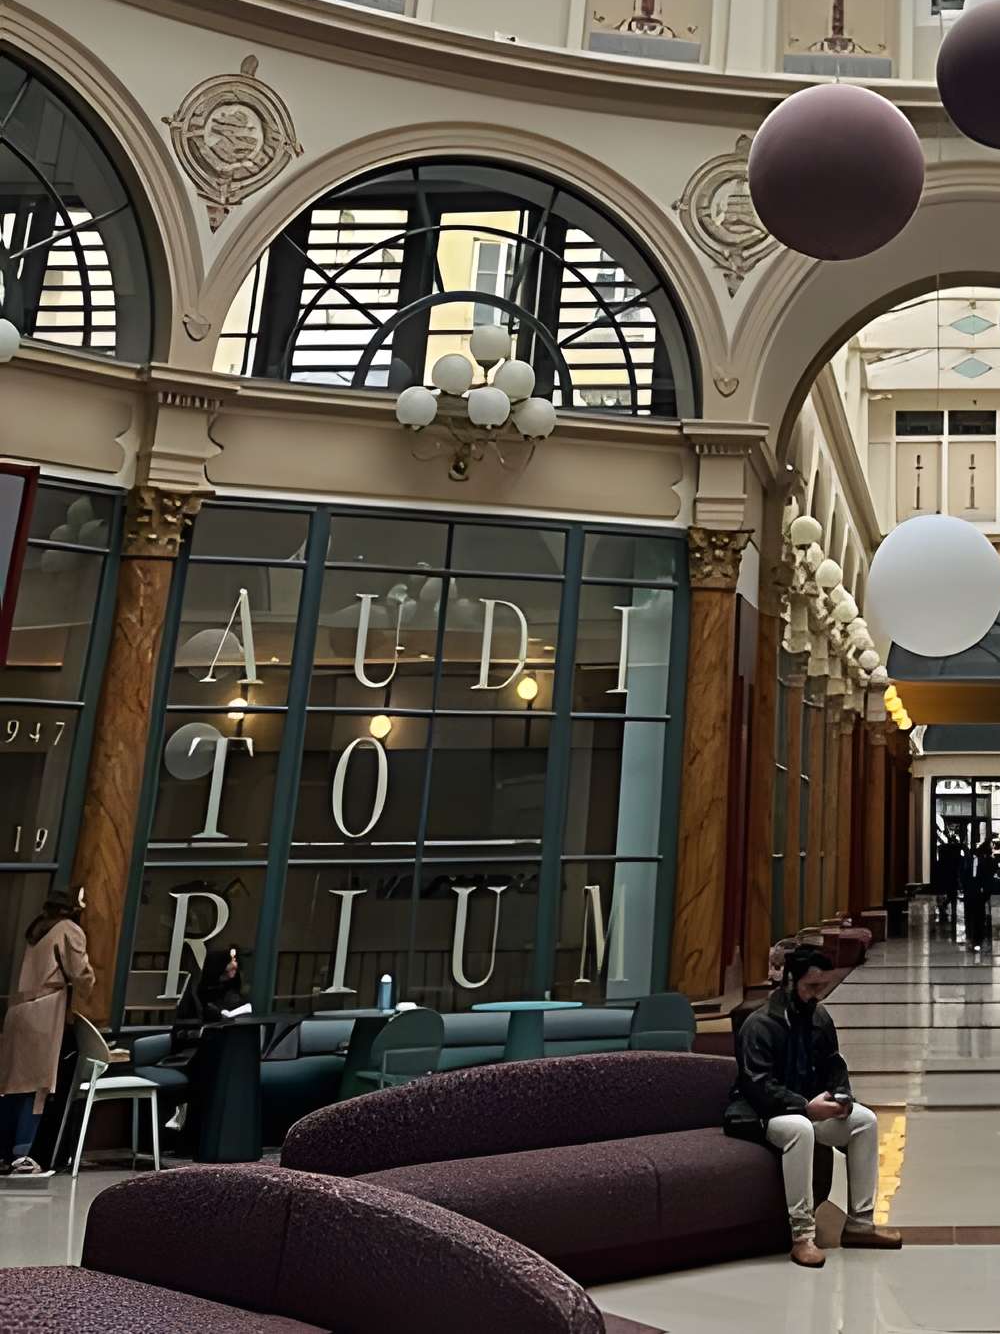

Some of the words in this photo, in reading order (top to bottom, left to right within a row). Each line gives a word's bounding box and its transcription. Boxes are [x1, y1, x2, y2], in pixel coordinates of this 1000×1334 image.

[199, 588, 634, 694] AUDI
[187, 737, 389, 838] TO
[155, 885, 630, 1000] RIUM
